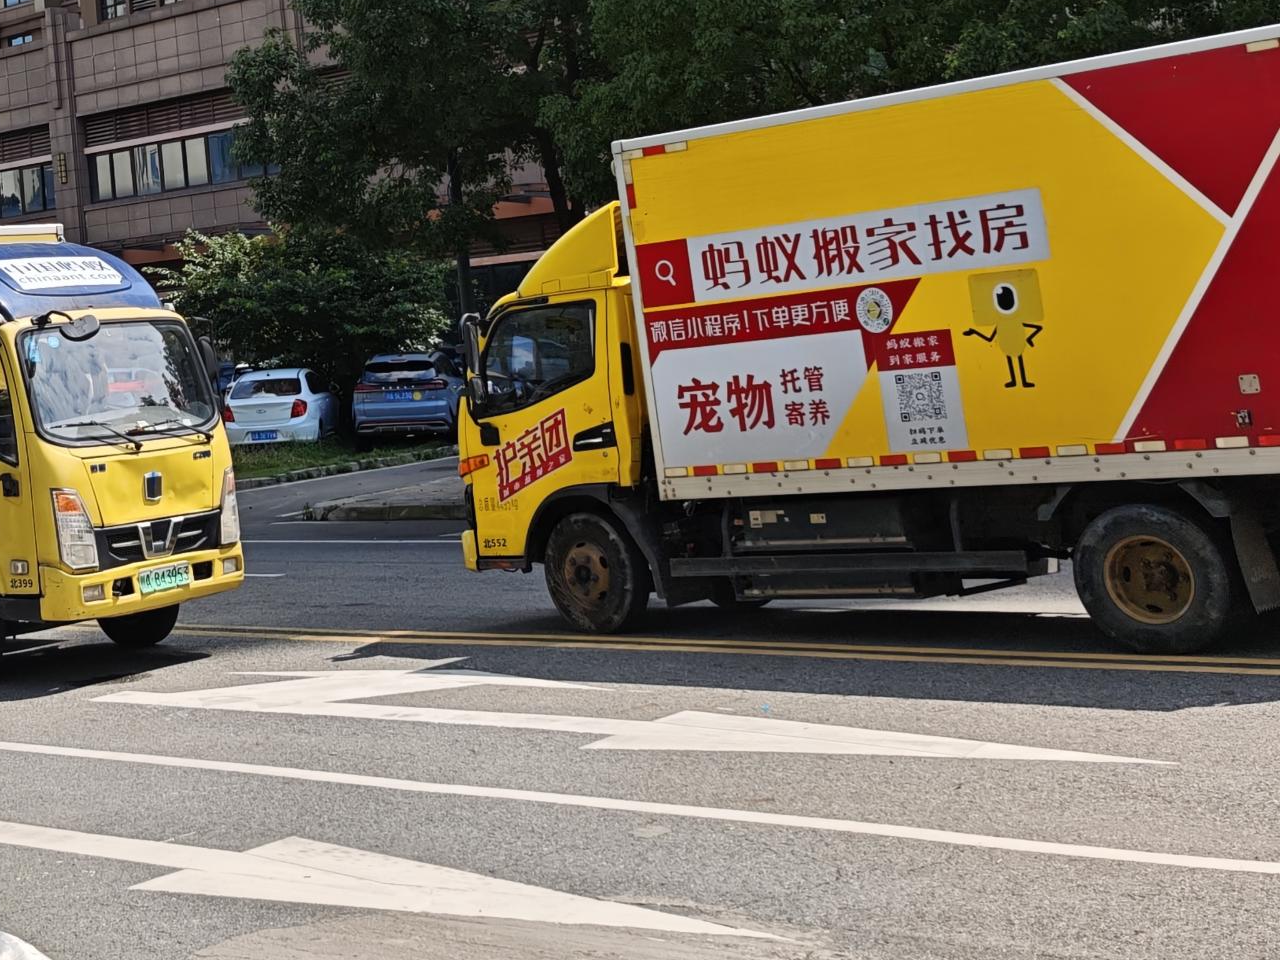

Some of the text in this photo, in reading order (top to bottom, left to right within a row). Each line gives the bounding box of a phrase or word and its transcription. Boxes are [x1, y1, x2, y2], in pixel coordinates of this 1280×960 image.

[700, 203, 1030, 291] 蚂蚁搬家找房
[18, 272, 120, 284] chinaant.com
[649, 298, 851, 343] 微信小程序!下单更方便
[779, 365, 824, 394] 托管
[677, 373, 776, 436] 宠物
[784, 398, 831, 427] 寄养
